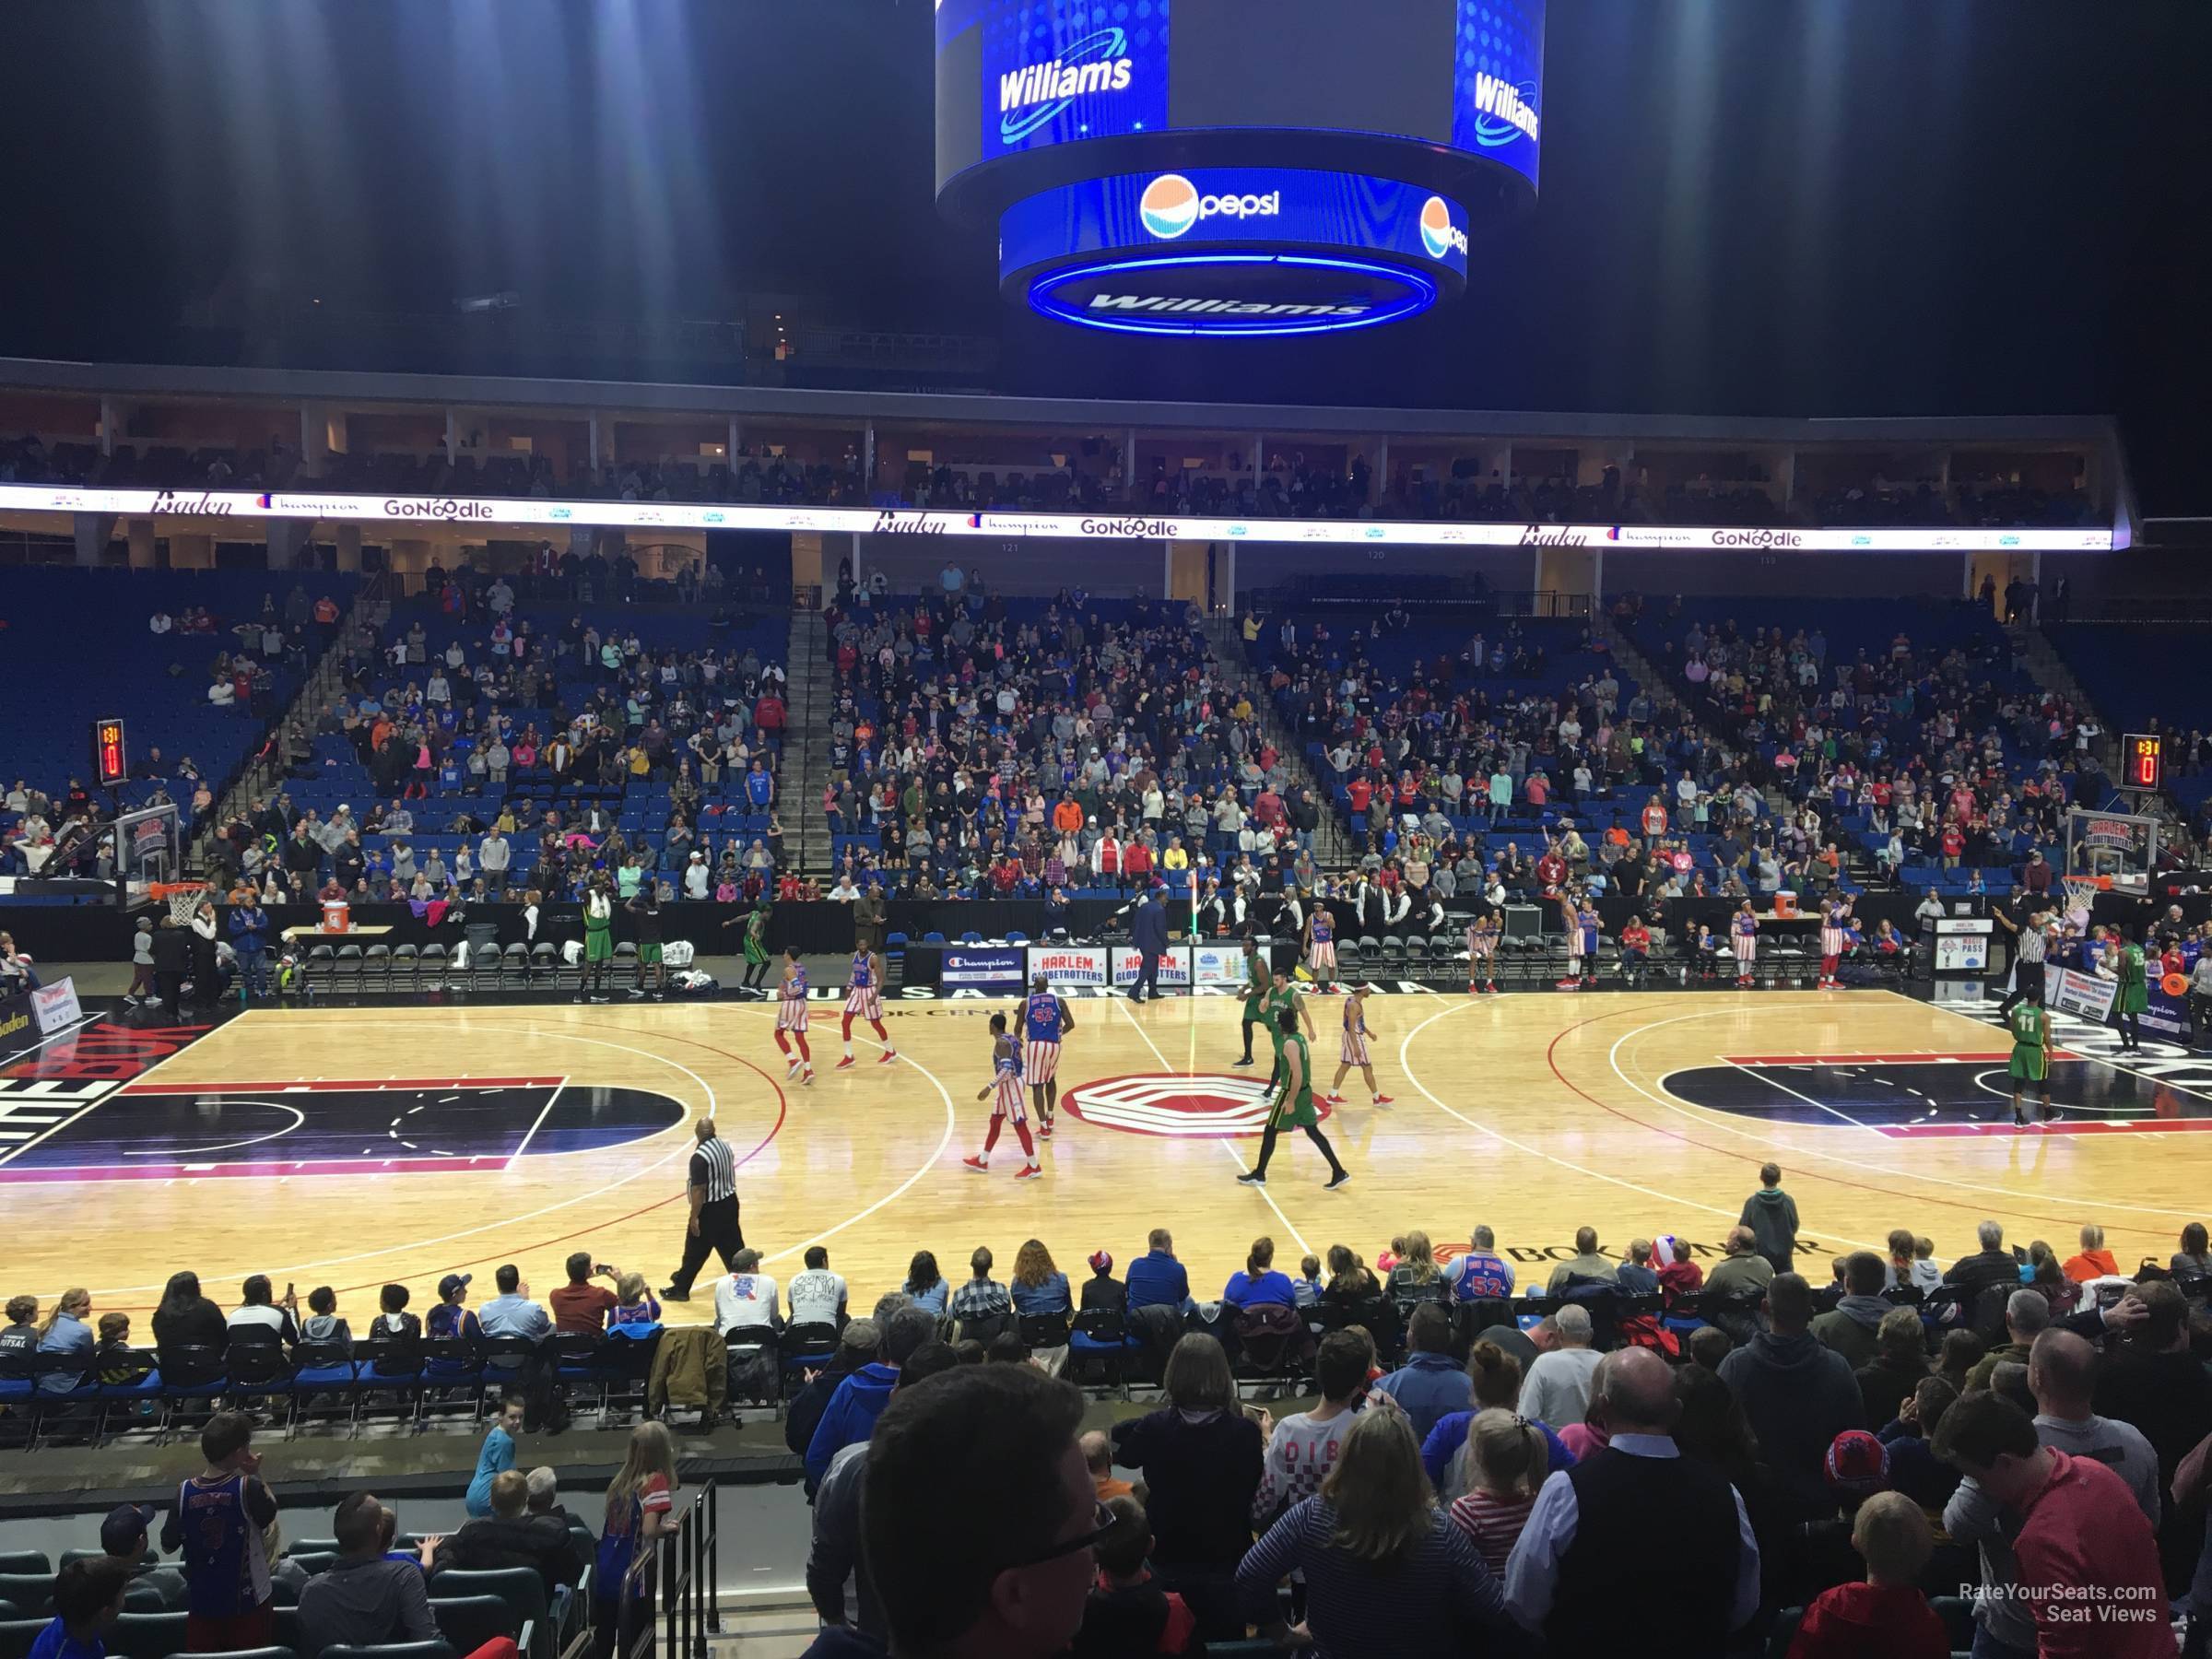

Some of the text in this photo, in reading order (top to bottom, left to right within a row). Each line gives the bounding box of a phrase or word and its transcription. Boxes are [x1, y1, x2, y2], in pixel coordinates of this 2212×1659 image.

[999, 55, 1133, 113] Williams
[1475, 71, 1538, 142] Williams
[1199, 190, 1280, 220] pepsi
[1089, 294, 1372, 315] Williams
[149, 491, 232, 515] Baden
[384, 493, 493, 516] GoNoodle
[873, 511, 947, 535] Baden
[1081, 517, 1178, 538] GoNoodle
[1519, 524, 1587, 546] Baden
[1712, 530, 1802, 550] GoNoodle
[1002, 544, 1019, 553] 121
[1367, 551, 1385, 559] 120
[2138, 740, 2159, 755] 1:31
[2142, 757, 2155, 782] 0
[1961, 944, 1983, 953] PASS
[948, 957, 1016, 971] Champion
[1041, 956, 1094, 971] HARLEM
[1125, 954, 1176, 970] HAEM
[1031, 970, 1103, 982] GOBETROTTERS
[1115, 969, 1186, 982] GLOBTTERS
[1034, 1006, 1053, 1023] 52
[0, 1011, 29, 1038] aden
[2018, 1015, 2036, 1032] 11
[1472, 1275, 1502, 1297] 52
